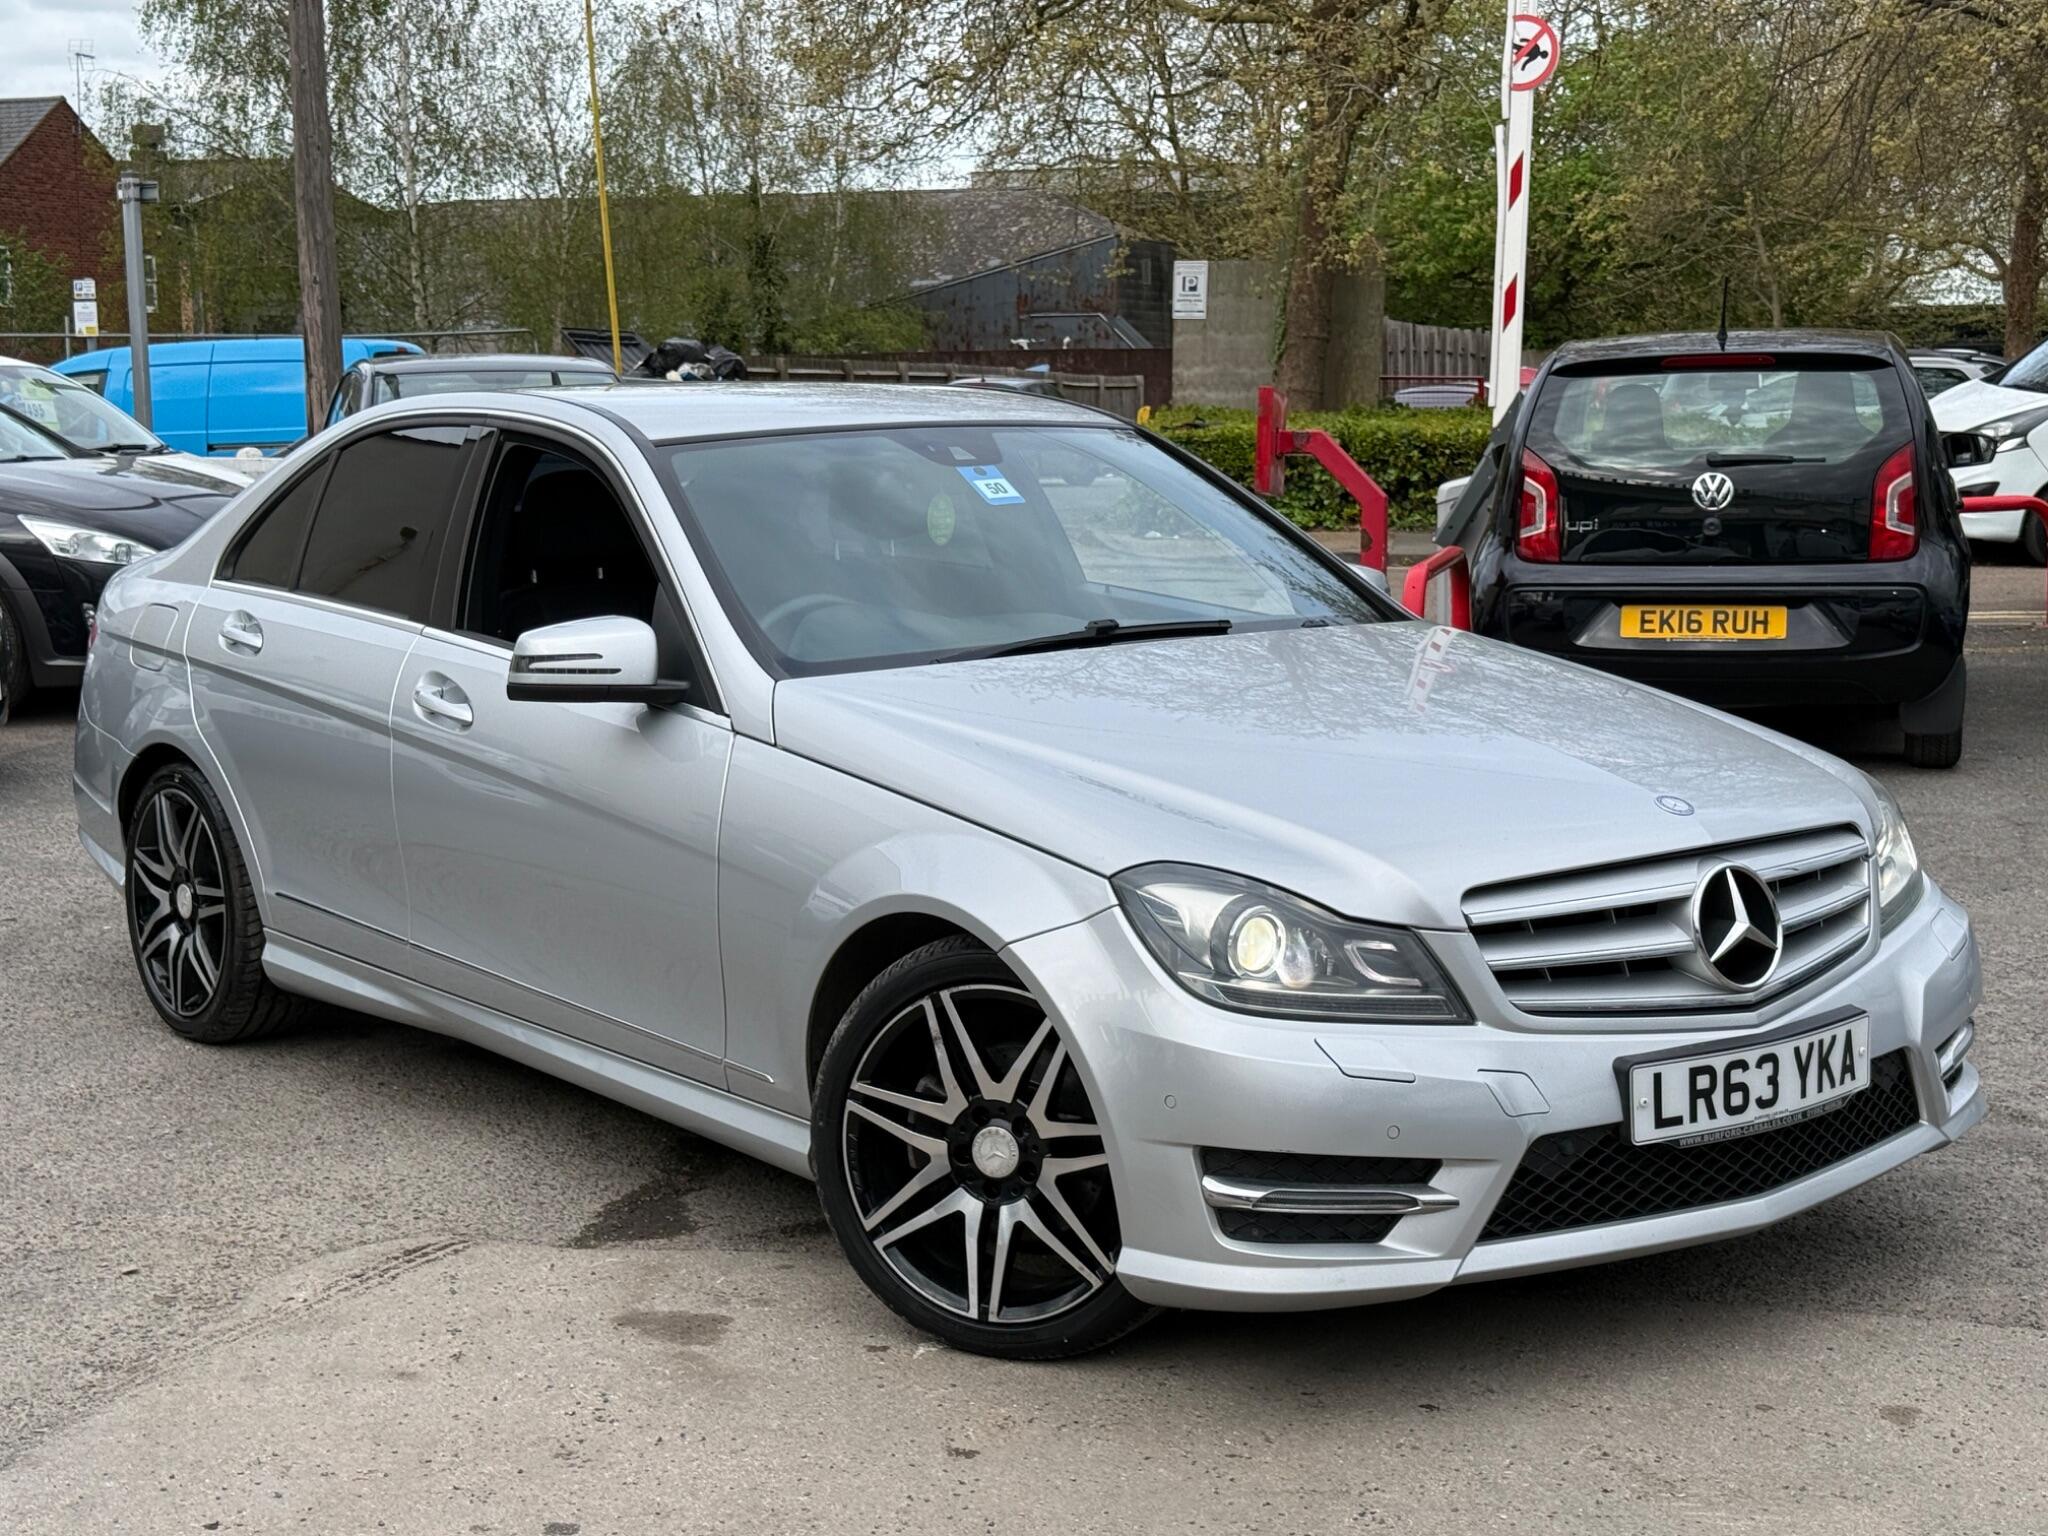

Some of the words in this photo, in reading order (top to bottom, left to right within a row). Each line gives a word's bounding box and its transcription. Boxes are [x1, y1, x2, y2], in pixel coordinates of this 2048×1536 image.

[984, 482, 1009, 495] 50
[1639, 609, 1703, 634] EK16
[1712, 609, 1769, 634] RUH
[1653, 1053, 1779, 1129] LR63
[1794, 1029, 1856, 1099] YKA
